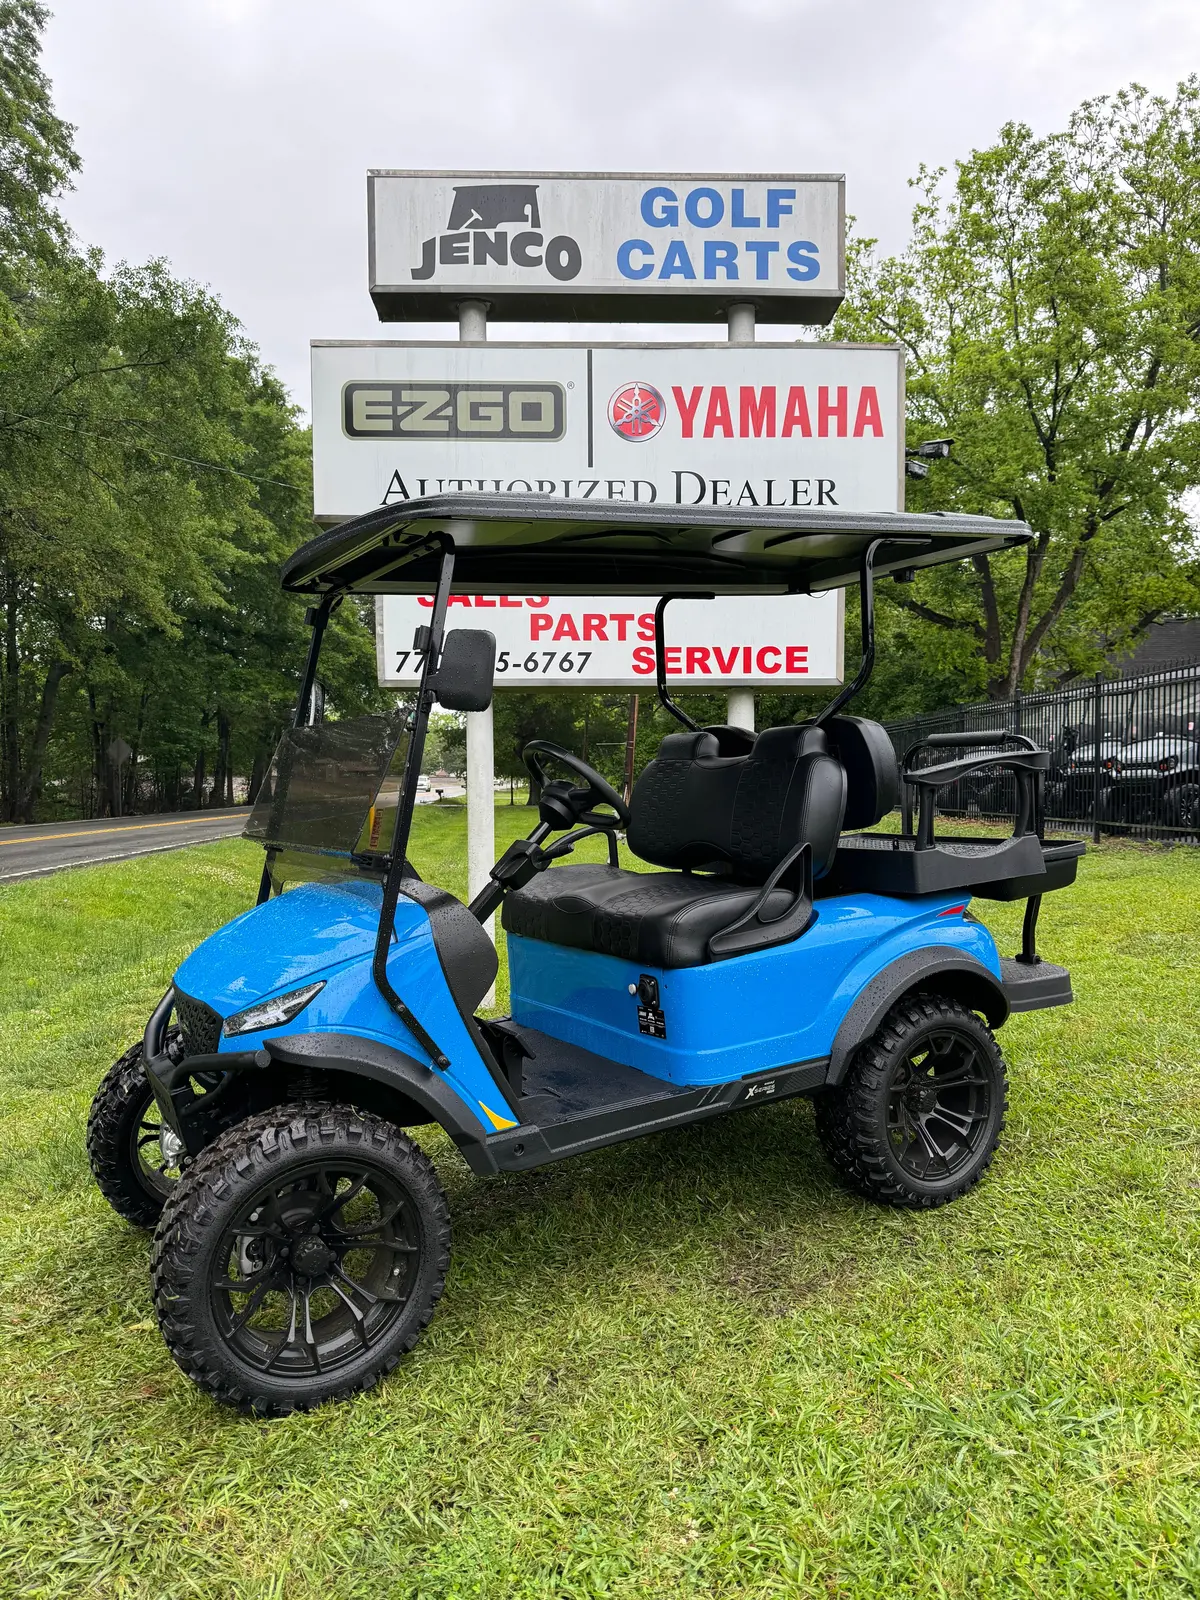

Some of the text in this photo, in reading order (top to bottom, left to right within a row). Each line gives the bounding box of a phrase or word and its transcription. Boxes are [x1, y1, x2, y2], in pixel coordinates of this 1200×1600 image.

[640, 187, 797, 229] GOLF
[411, 230, 582, 282] JENCO
[616, 238, 821, 281] CARTS
[671, 385, 885, 438] YAMAHA
[671, 470, 840, 507] DEALER
[530, 612, 657, 642] PARTS
[631, 646, 809, 675] SERVICE
